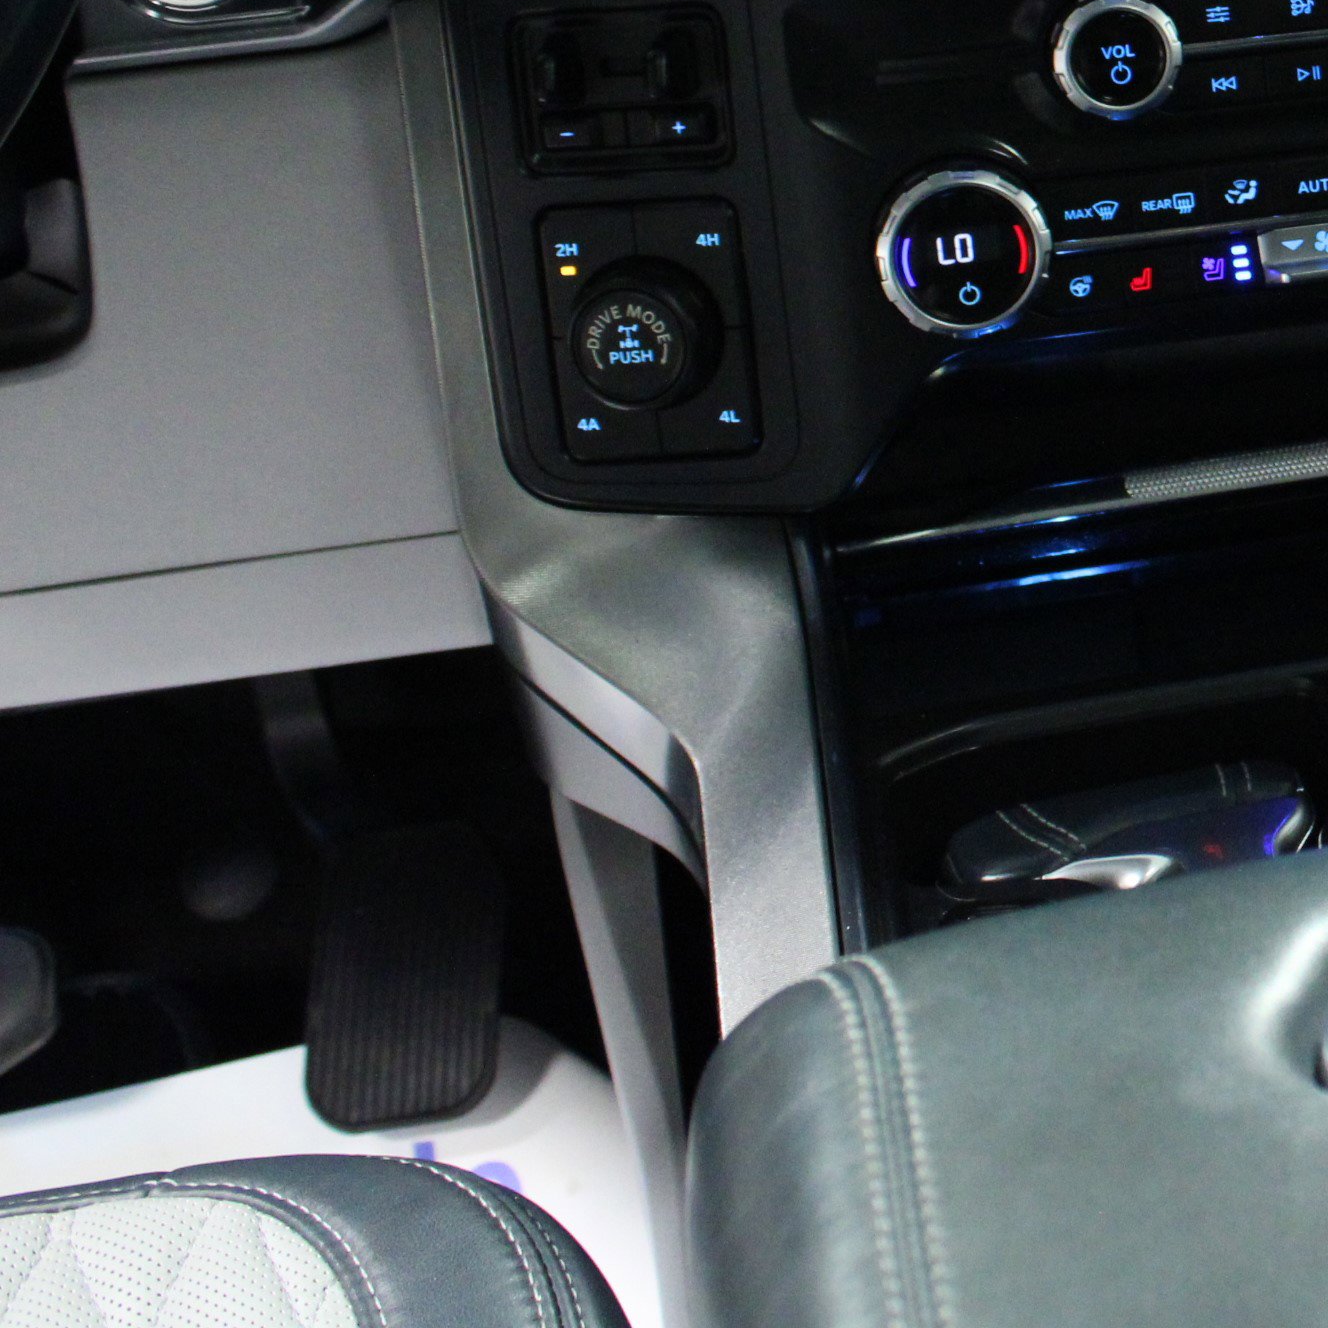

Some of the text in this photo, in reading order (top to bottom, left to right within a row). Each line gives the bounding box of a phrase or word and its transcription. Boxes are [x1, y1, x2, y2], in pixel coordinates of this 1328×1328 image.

[1101, 43, 1136, 60] VOL
[1141, 198, 1172, 212] REAR
[1064, 206, 1094, 221] MAX
[695, 232, 721, 248] 4H
[554, 242, 580, 258] 2H
[936, 232, 975, 266] LO
[586, 303, 673, 350] DRIVE MODE
[608, 349, 654, 366] PUSH
[577, 417, 602, 433] 4A
[718, 409, 741, 425] 4L
